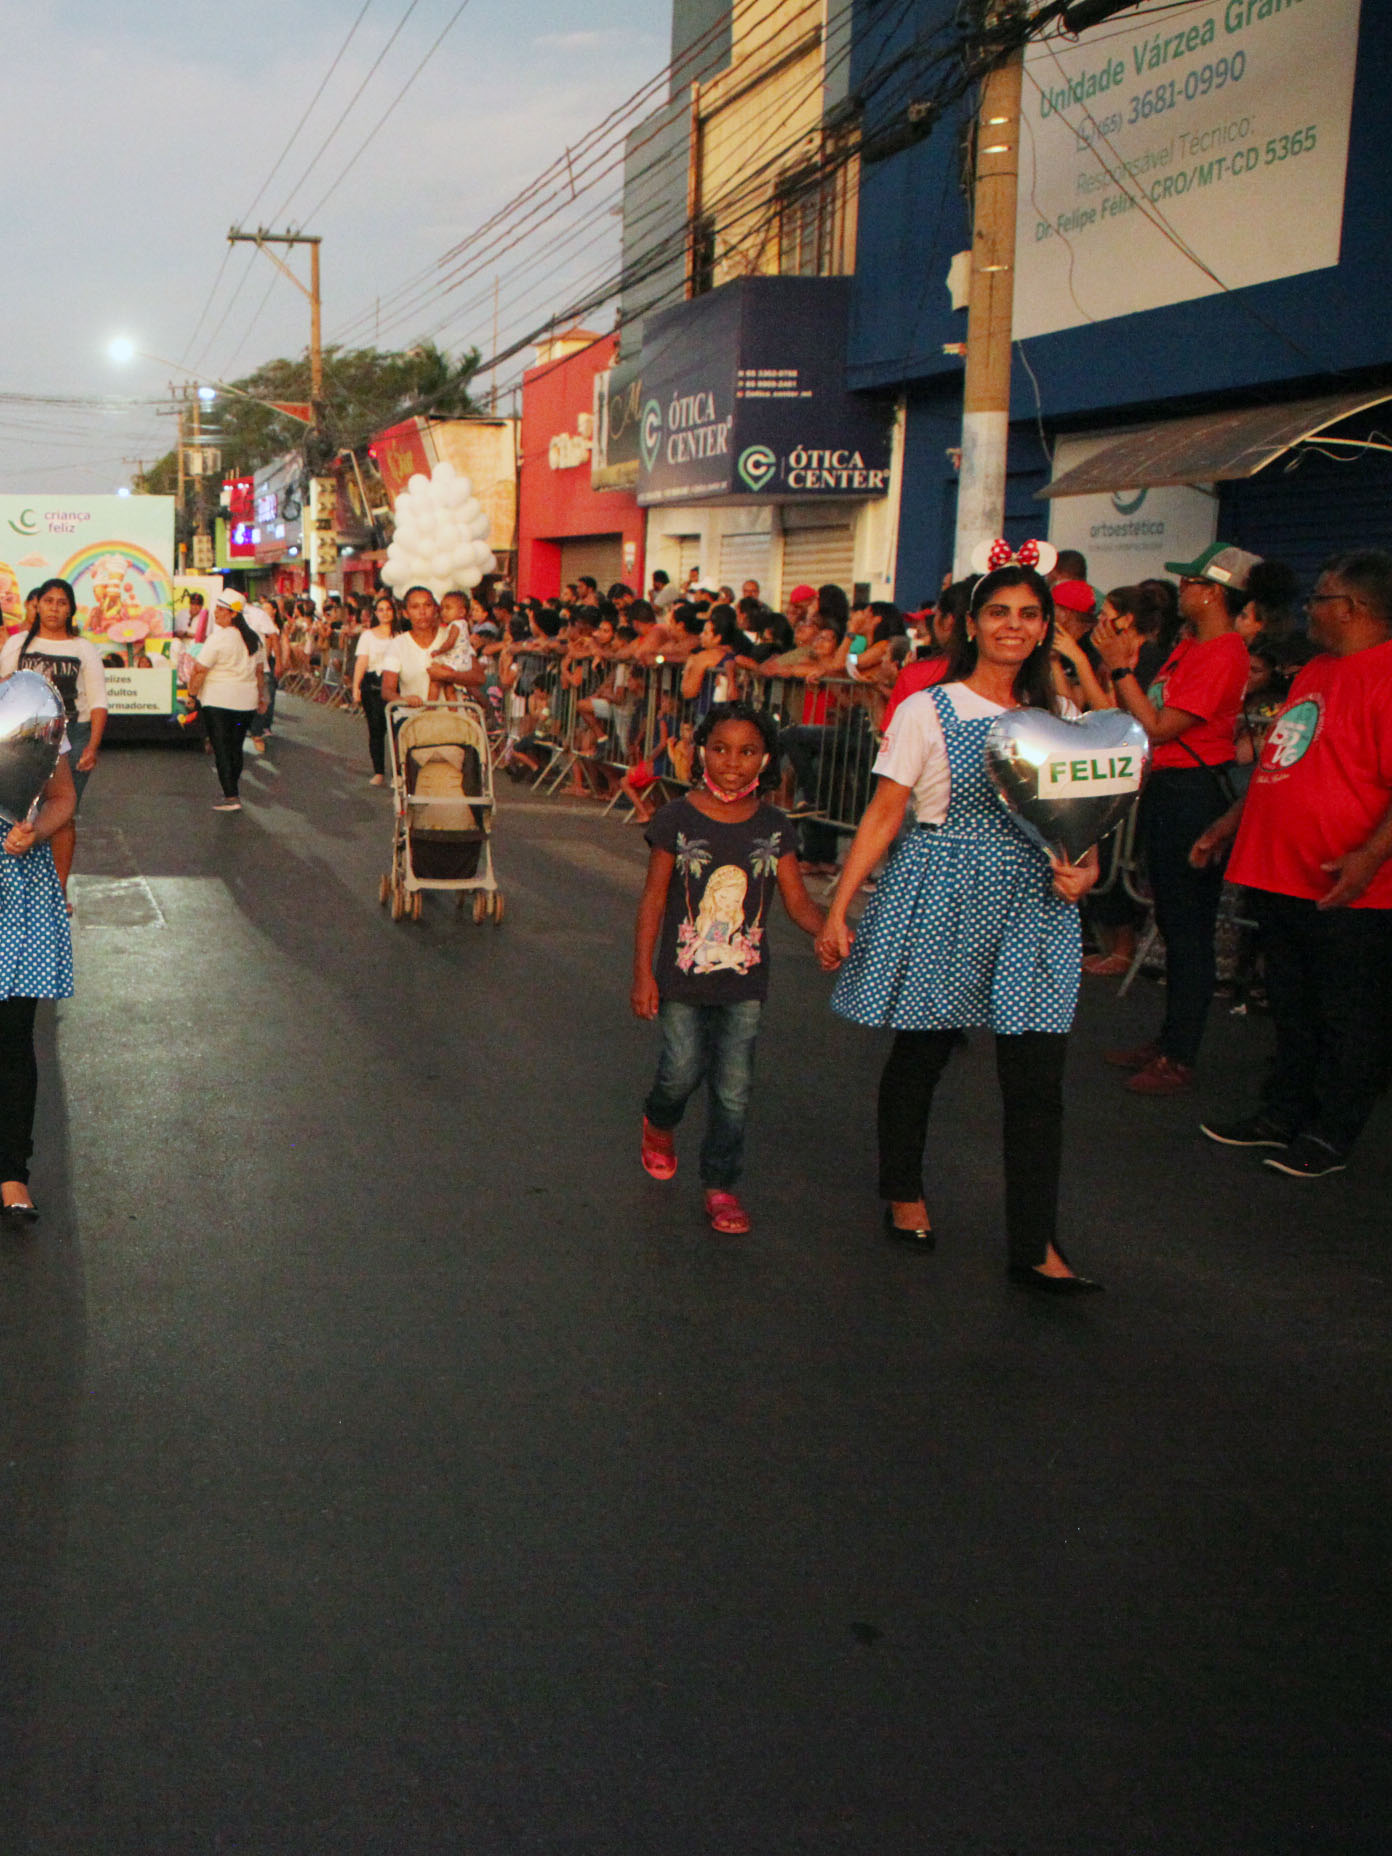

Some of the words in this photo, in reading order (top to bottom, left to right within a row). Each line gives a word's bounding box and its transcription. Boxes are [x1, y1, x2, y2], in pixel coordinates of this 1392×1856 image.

[1040, 57, 1126, 119] Unidade
[1133, 18, 1215, 76] Várzea
[1127, 50, 1246, 124] 3681-0990
[1058, 207, 1097, 232] Felipe
[1151, 147, 1259, 203] CRO/MT-CD
[1264, 125, 1318, 165] 5365
[669, 391, 716, 431] ÓTICA
[788, 444, 865, 469] ÓTICA
[44, 509, 91, 523] criança
[48, 521, 76, 534] feliz
[104, 674, 132, 684] elizes
[107, 687, 138, 698] dultos
[1049, 756, 1134, 784] FELIZ
